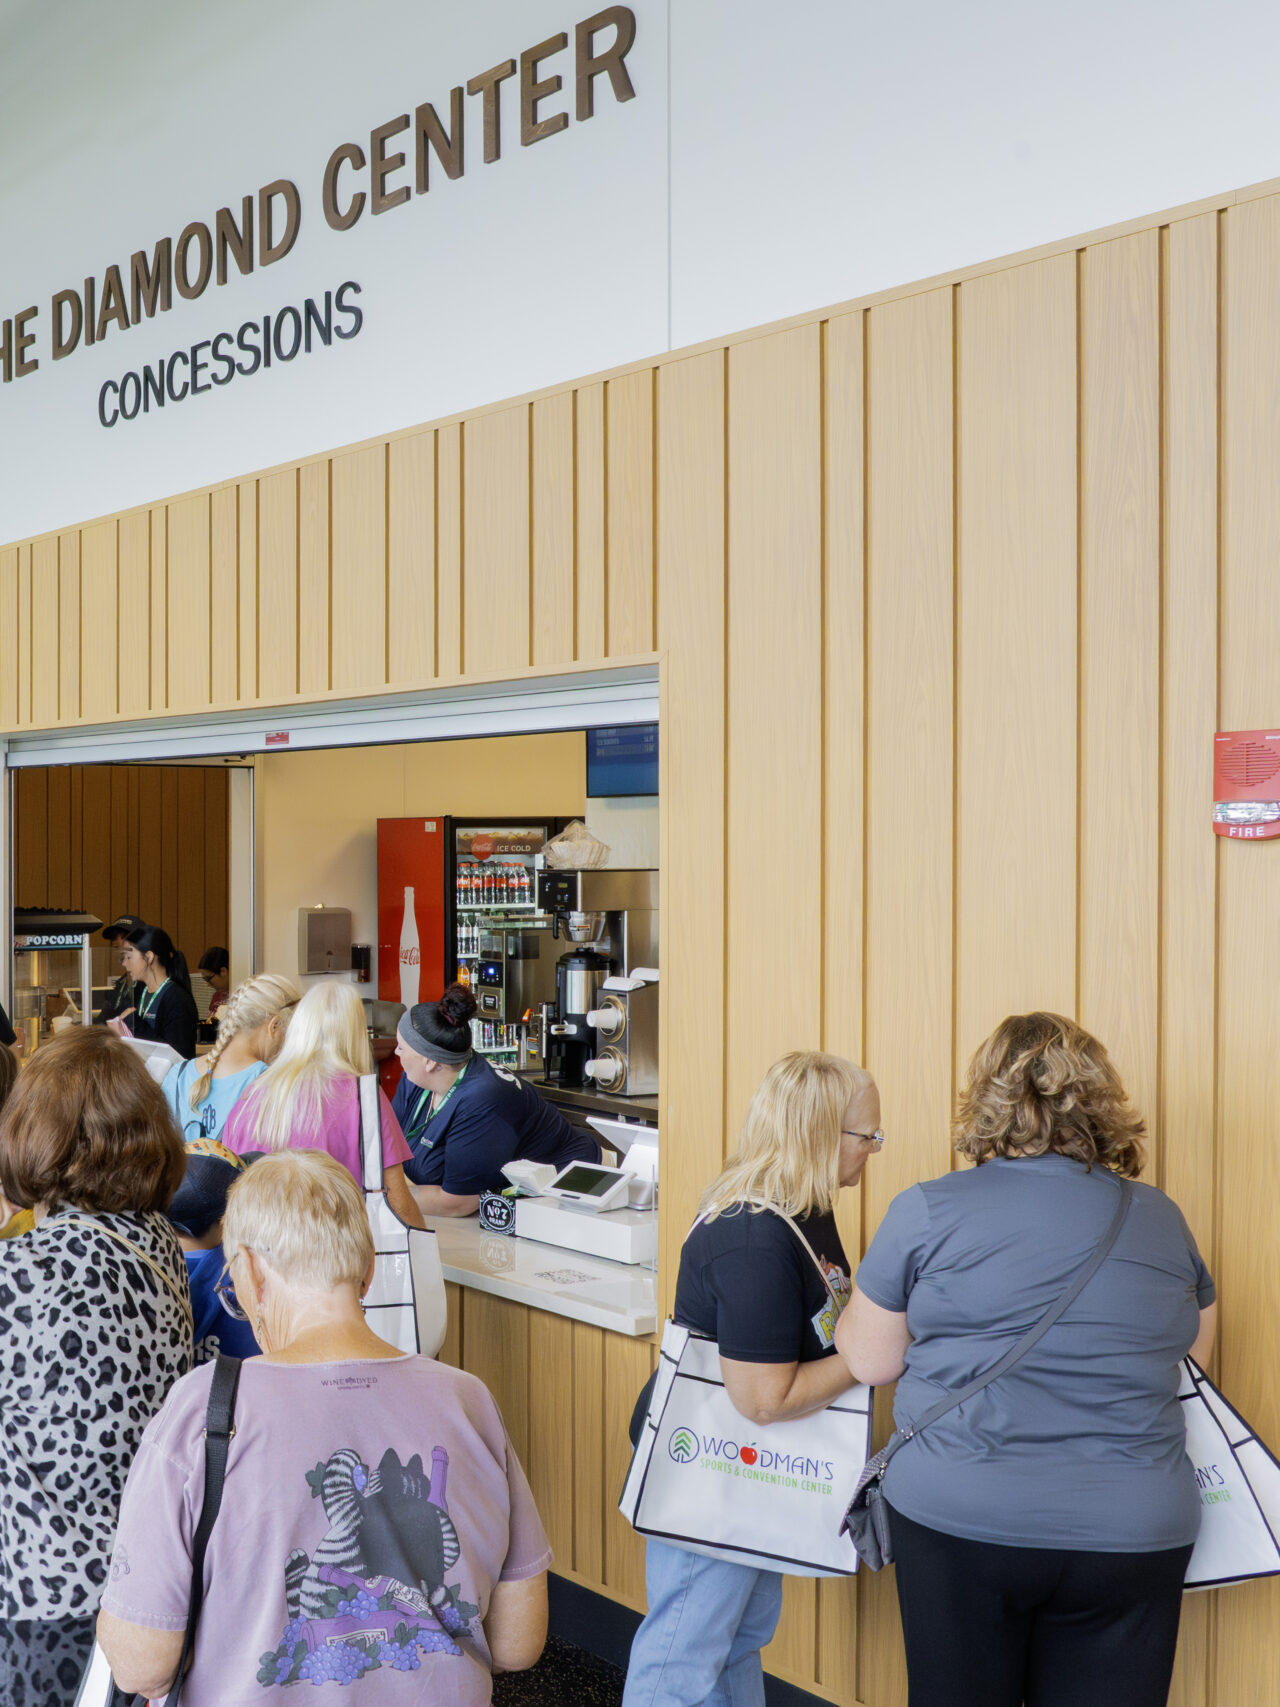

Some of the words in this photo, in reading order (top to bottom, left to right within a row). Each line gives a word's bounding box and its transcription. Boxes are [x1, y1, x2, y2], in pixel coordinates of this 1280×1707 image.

[51, 179, 302, 362] DIAMOND
[322, 5, 637, 232] CENTER
[98, 281, 364, 428] CONCESSIONS
[1229, 826, 1265, 837] FIRE
[25, 934, 84, 945] POPCORN
[700, 1458, 732, 1475] SPORTS
[734, 1467, 740, 1477] &
[742, 1468, 798, 1489] CONVENTION
[801, 1479, 833, 1496] CENTER
